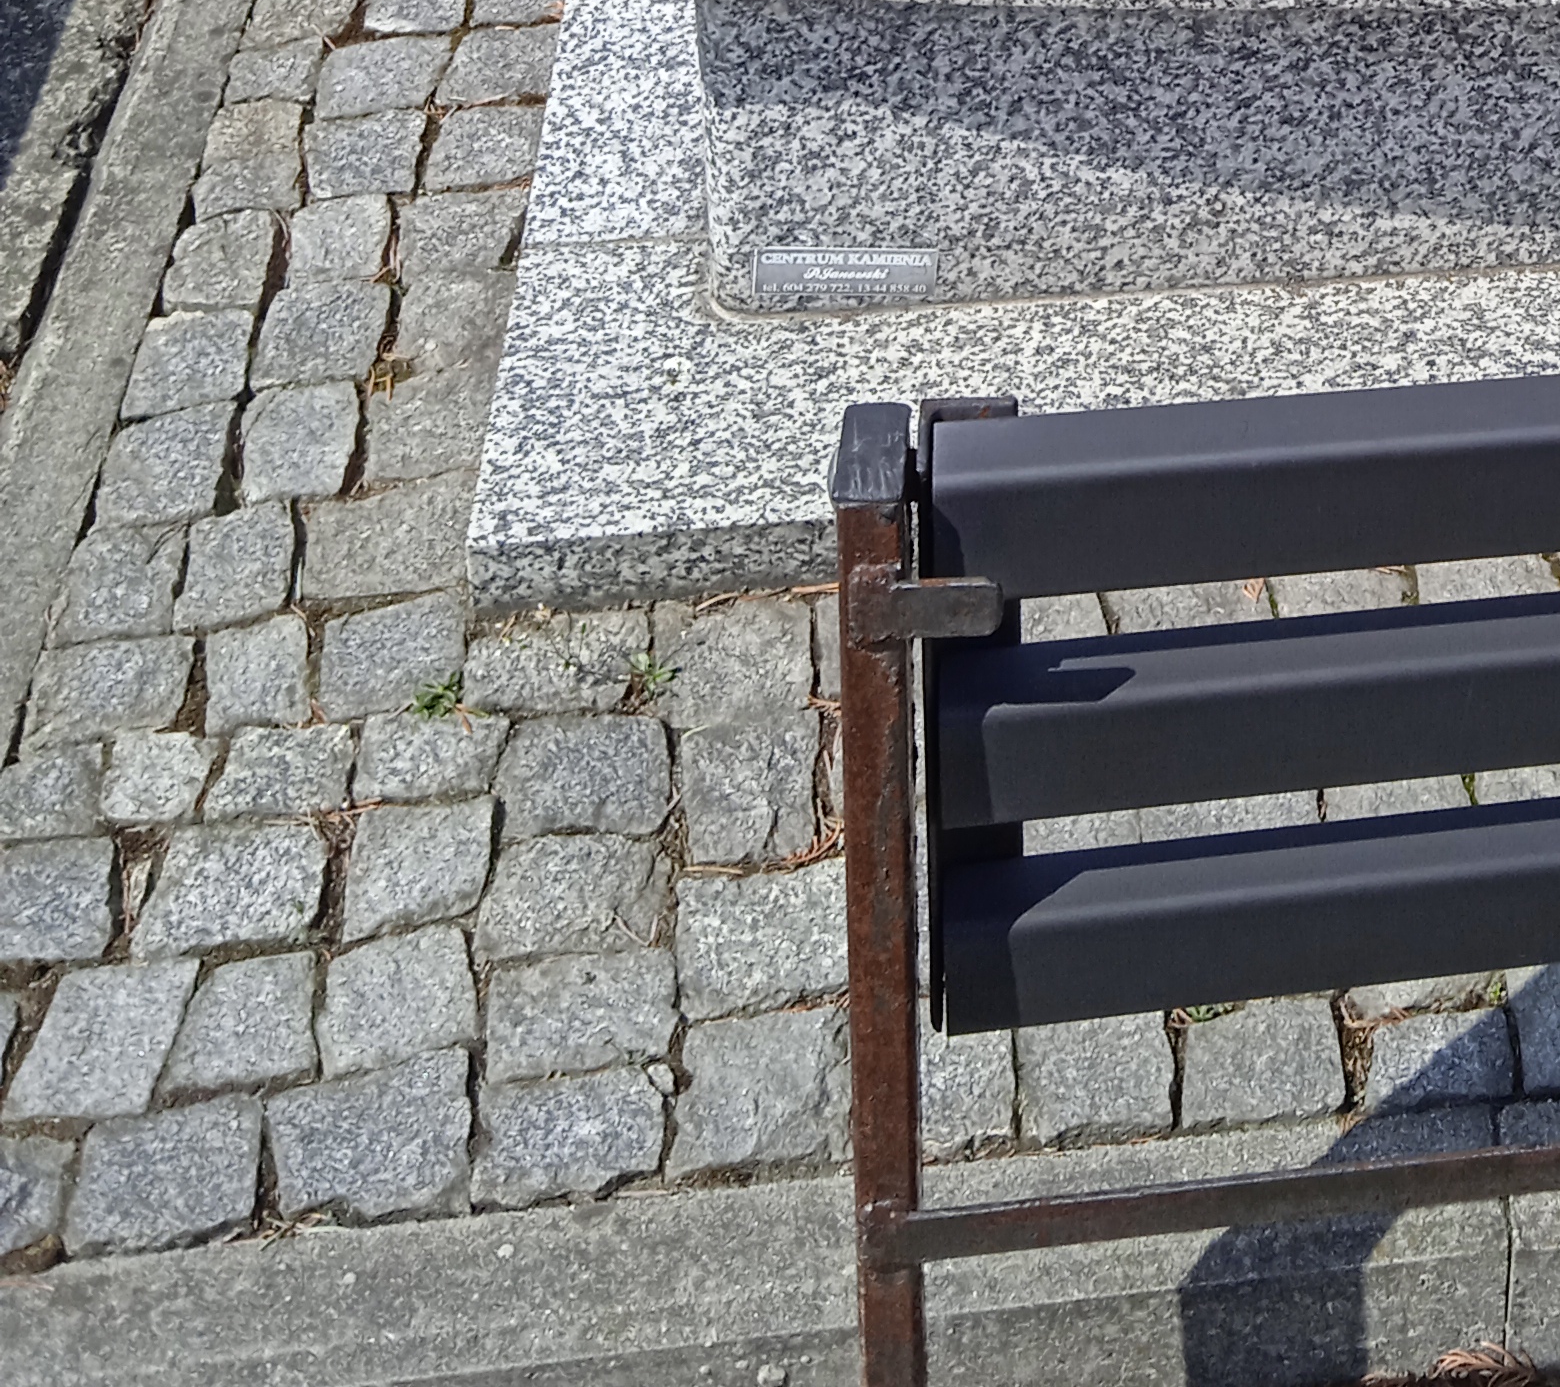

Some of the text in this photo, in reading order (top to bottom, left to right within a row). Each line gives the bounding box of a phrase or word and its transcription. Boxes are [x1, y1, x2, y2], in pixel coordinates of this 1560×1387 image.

[760, 252, 932, 267] CENTRUM KAMIENIA
[782, 282, 803, 292] 604
[805, 283, 828, 293] 279
